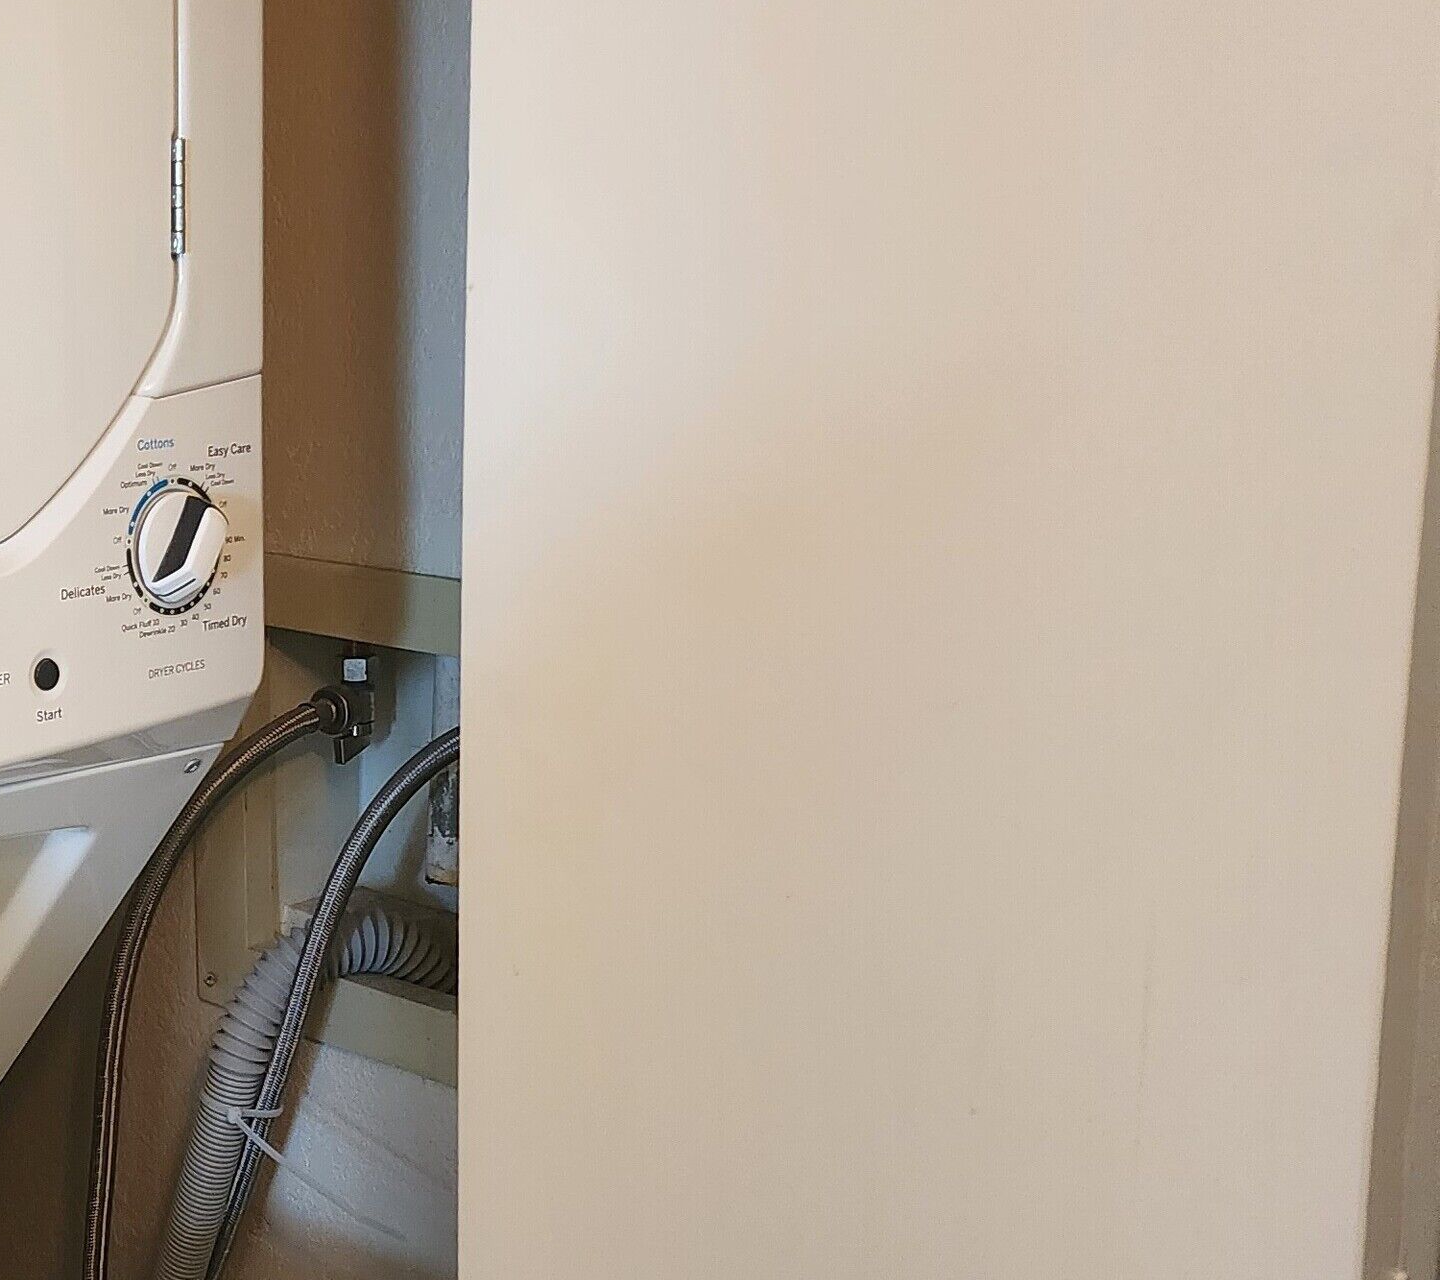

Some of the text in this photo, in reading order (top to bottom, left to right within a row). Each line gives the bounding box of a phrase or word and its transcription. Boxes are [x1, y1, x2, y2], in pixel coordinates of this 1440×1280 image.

[137, 438, 175, 451] Cottons
[207, 443, 251, 458] Easy Care
[60, 585, 106, 601] Delicates
[202, 615, 247, 631] Timed Dry
[148, 659, 206, 679] DRYER CYCLES
[36, 707, 62, 723] Start
